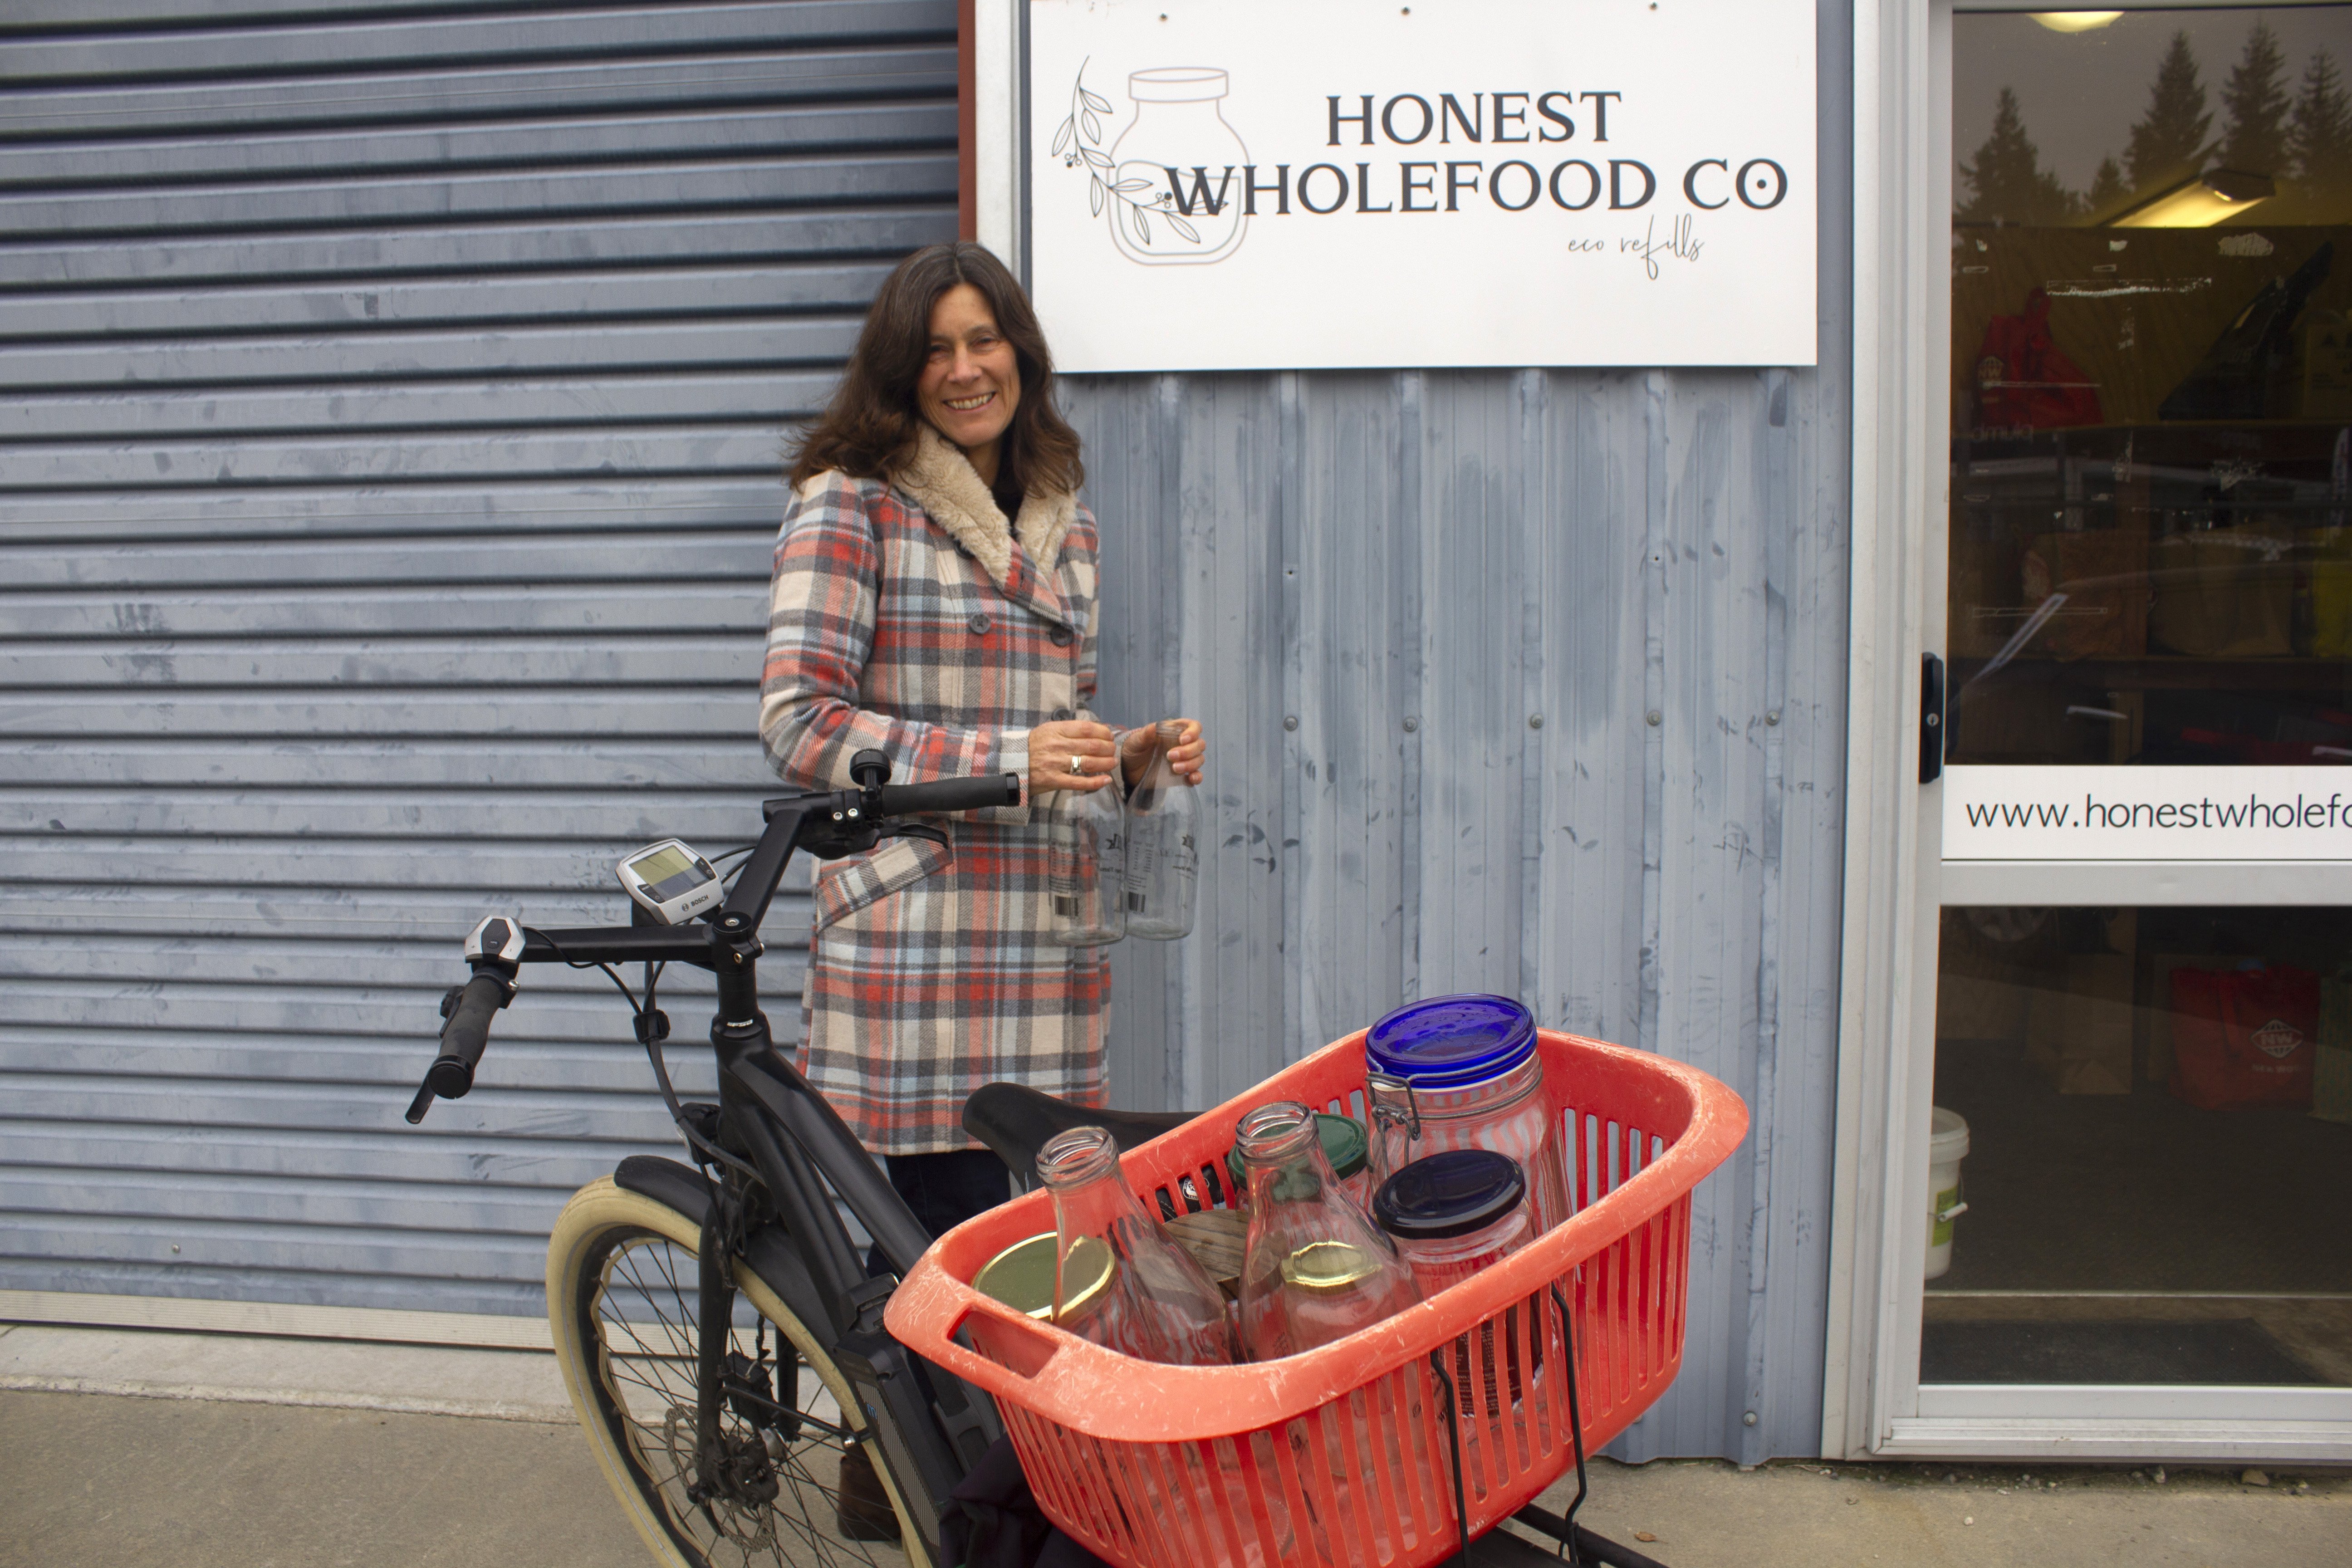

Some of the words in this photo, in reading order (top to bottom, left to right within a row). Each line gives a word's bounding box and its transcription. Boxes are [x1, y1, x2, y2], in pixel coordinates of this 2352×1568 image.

[1327, 92, 1622, 145] HONEST
[1164, 160, 1656, 216] WHOLEFOOD
[1683, 159, 1788, 210] CO
[1568, 239, 1604, 252] eco
[1621, 213, 1705, 280] refills
[691, 895, 709, 906] BOSCH
